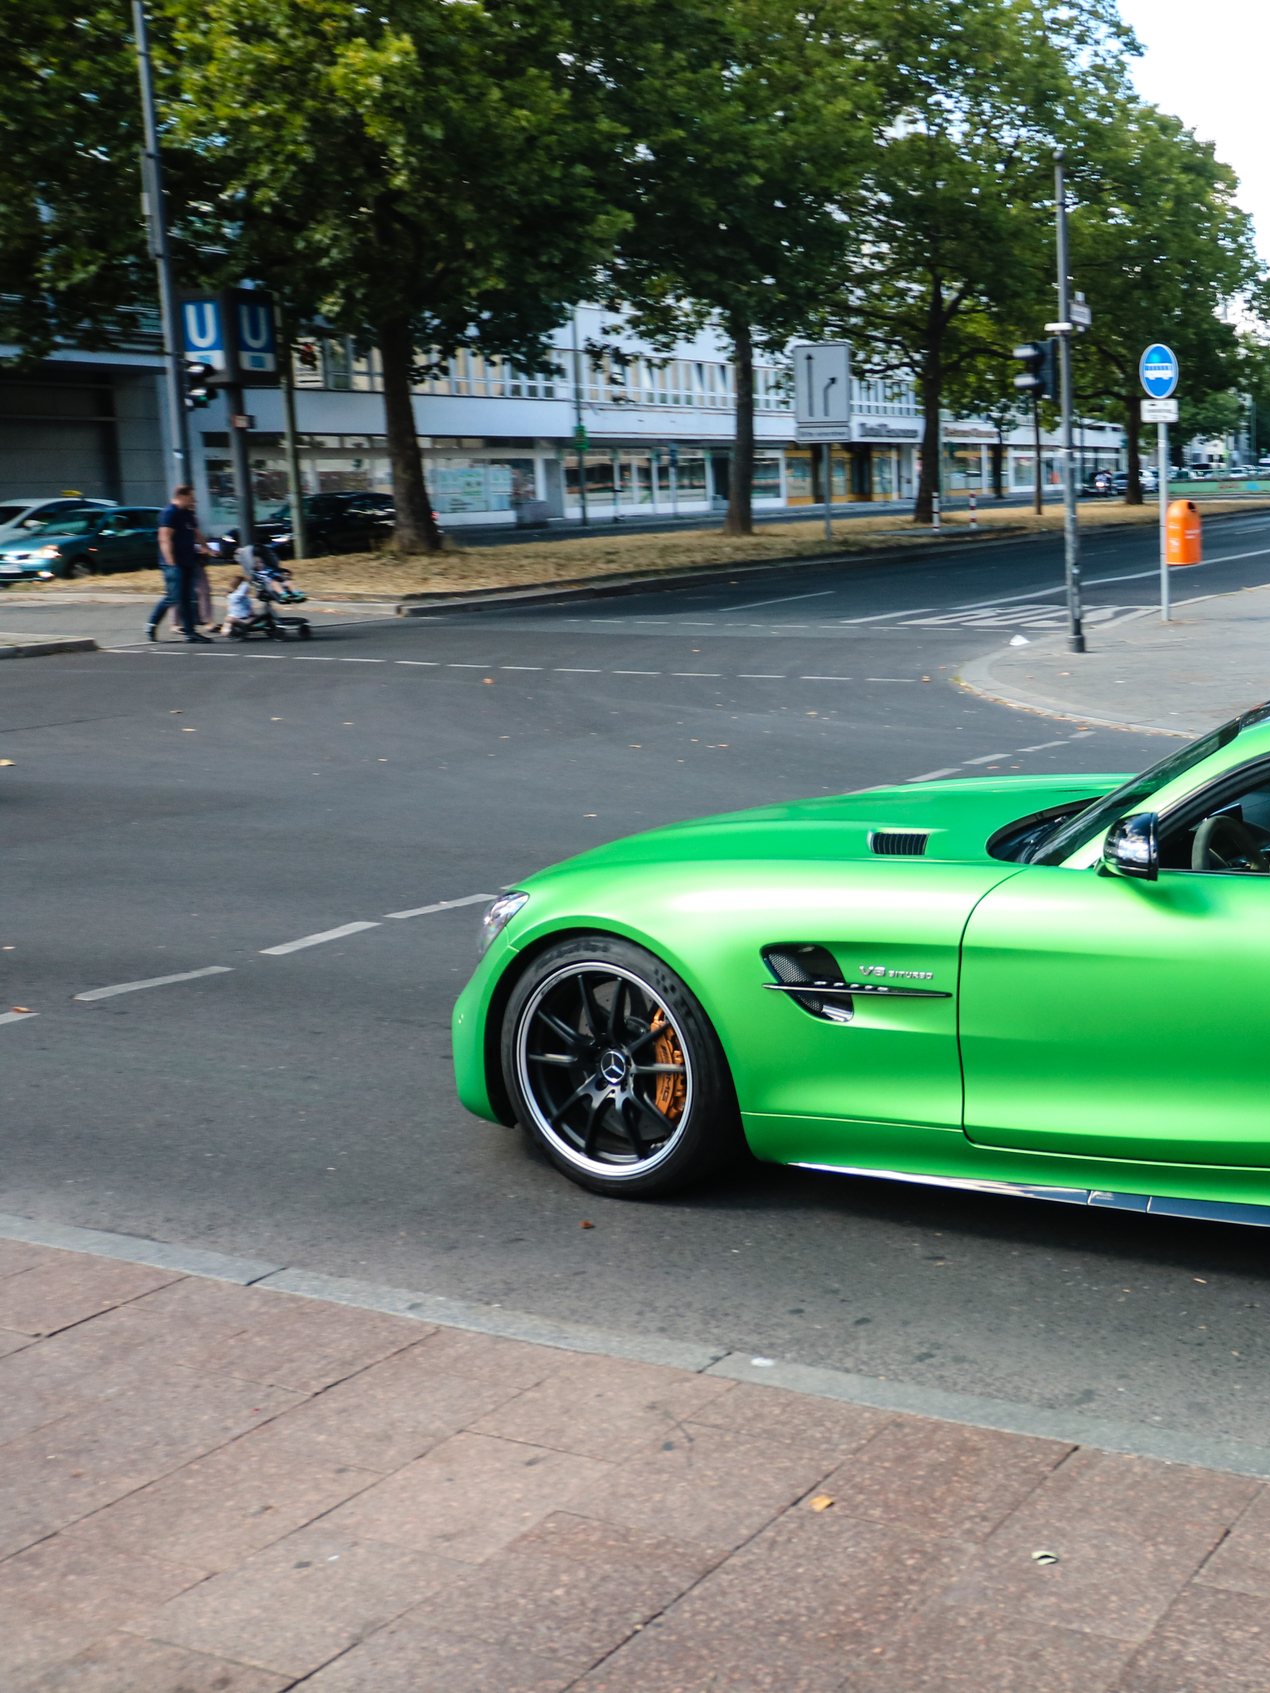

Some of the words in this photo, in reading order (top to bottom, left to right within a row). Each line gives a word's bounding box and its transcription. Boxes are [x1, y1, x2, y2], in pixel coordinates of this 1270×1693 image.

[185, 303, 216, 348] U
[240, 304, 268, 349] U
[859, 965, 886, 977] V8
[888, 970, 933, 980] BITURBO
